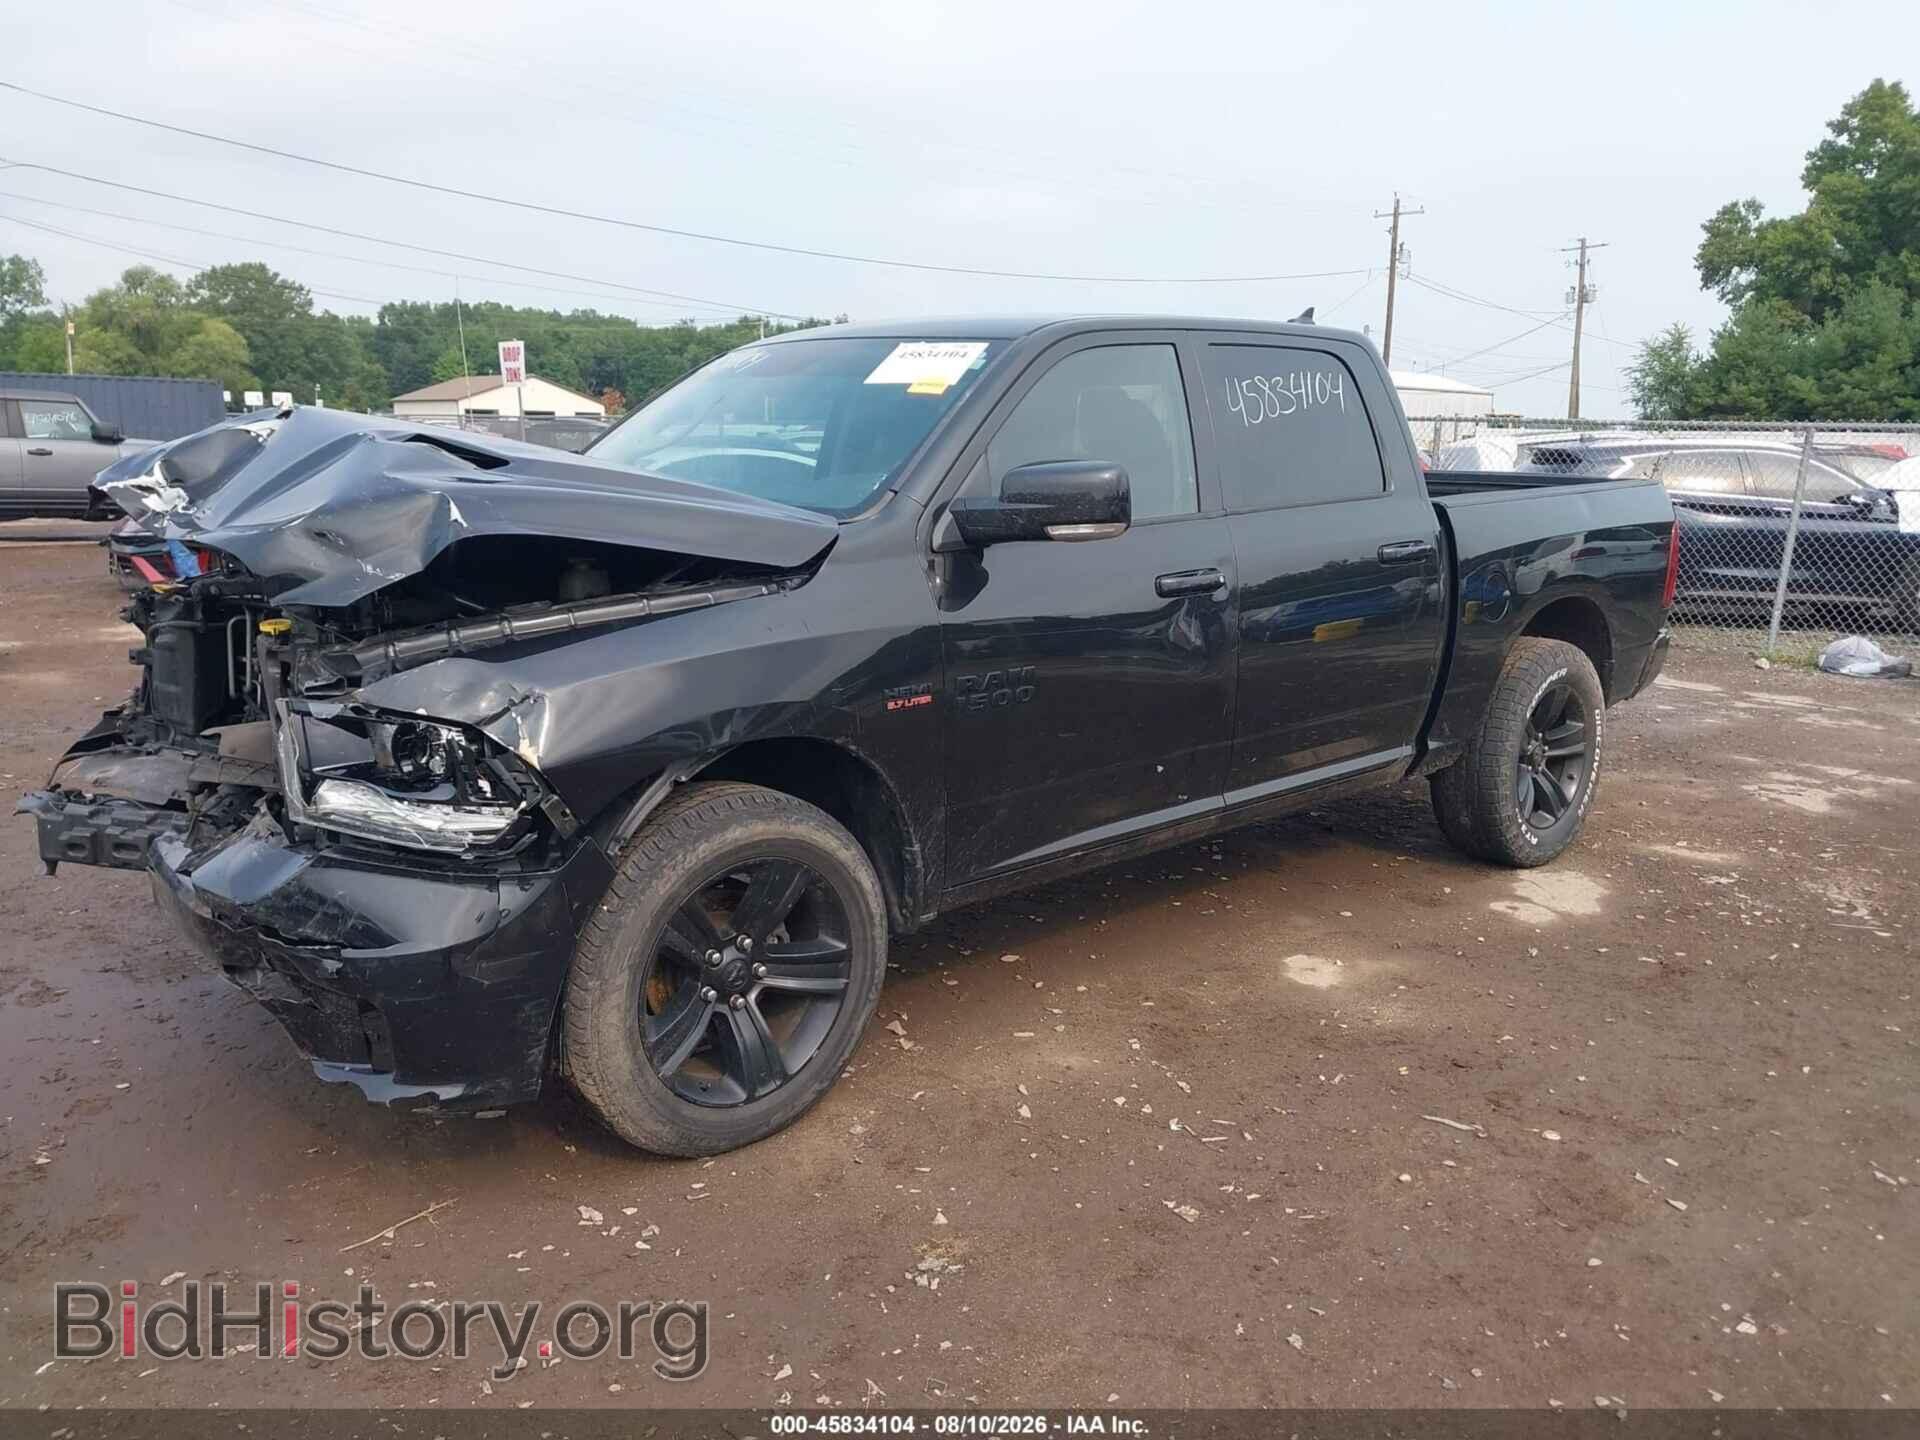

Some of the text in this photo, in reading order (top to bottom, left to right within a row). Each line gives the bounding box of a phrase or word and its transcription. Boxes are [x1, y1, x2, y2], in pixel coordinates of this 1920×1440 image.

[502, 346, 521, 362] DROP
[1224, 371, 1345, 427] 45834104
[956, 665, 1036, 690] RAM
